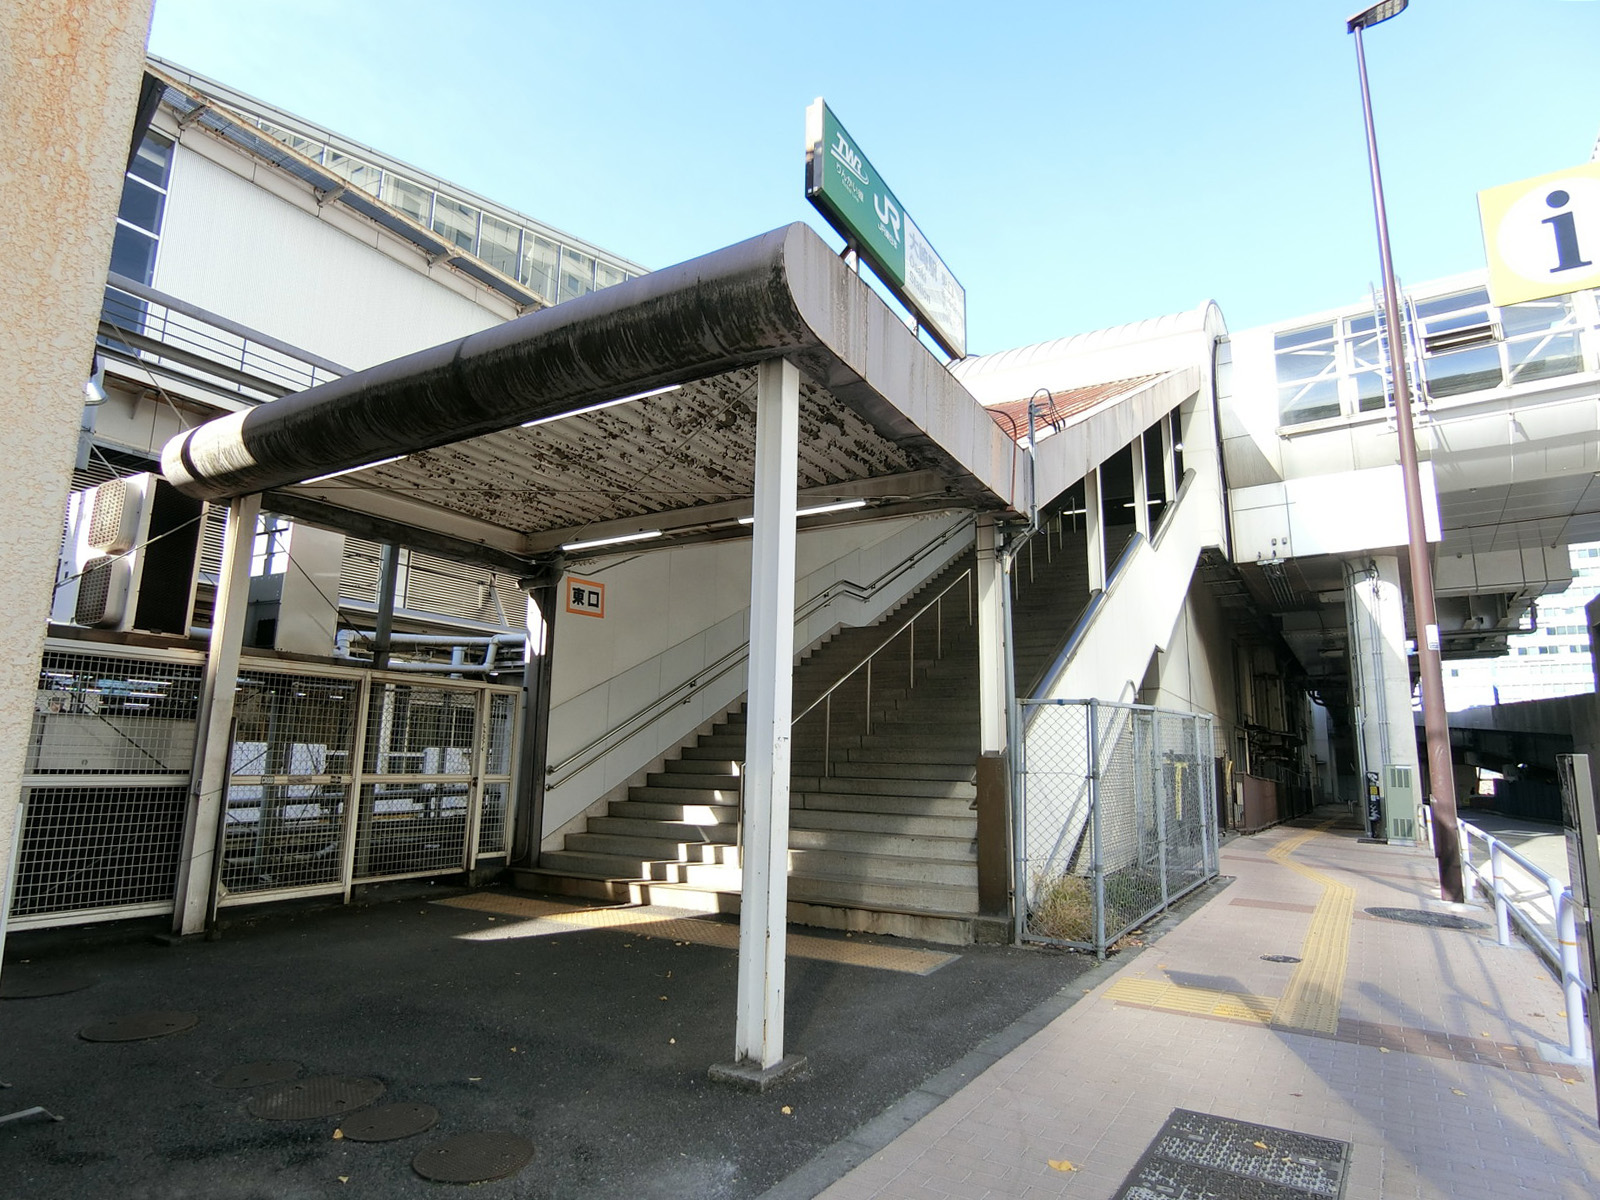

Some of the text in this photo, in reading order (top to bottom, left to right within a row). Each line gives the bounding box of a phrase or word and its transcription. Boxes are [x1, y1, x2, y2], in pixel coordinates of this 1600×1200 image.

[834, 131, 864, 177] TWR
[873, 193, 900, 243] JR
[1541, 189, 1593, 273] i
[572, 587, 599, 608] 東口
